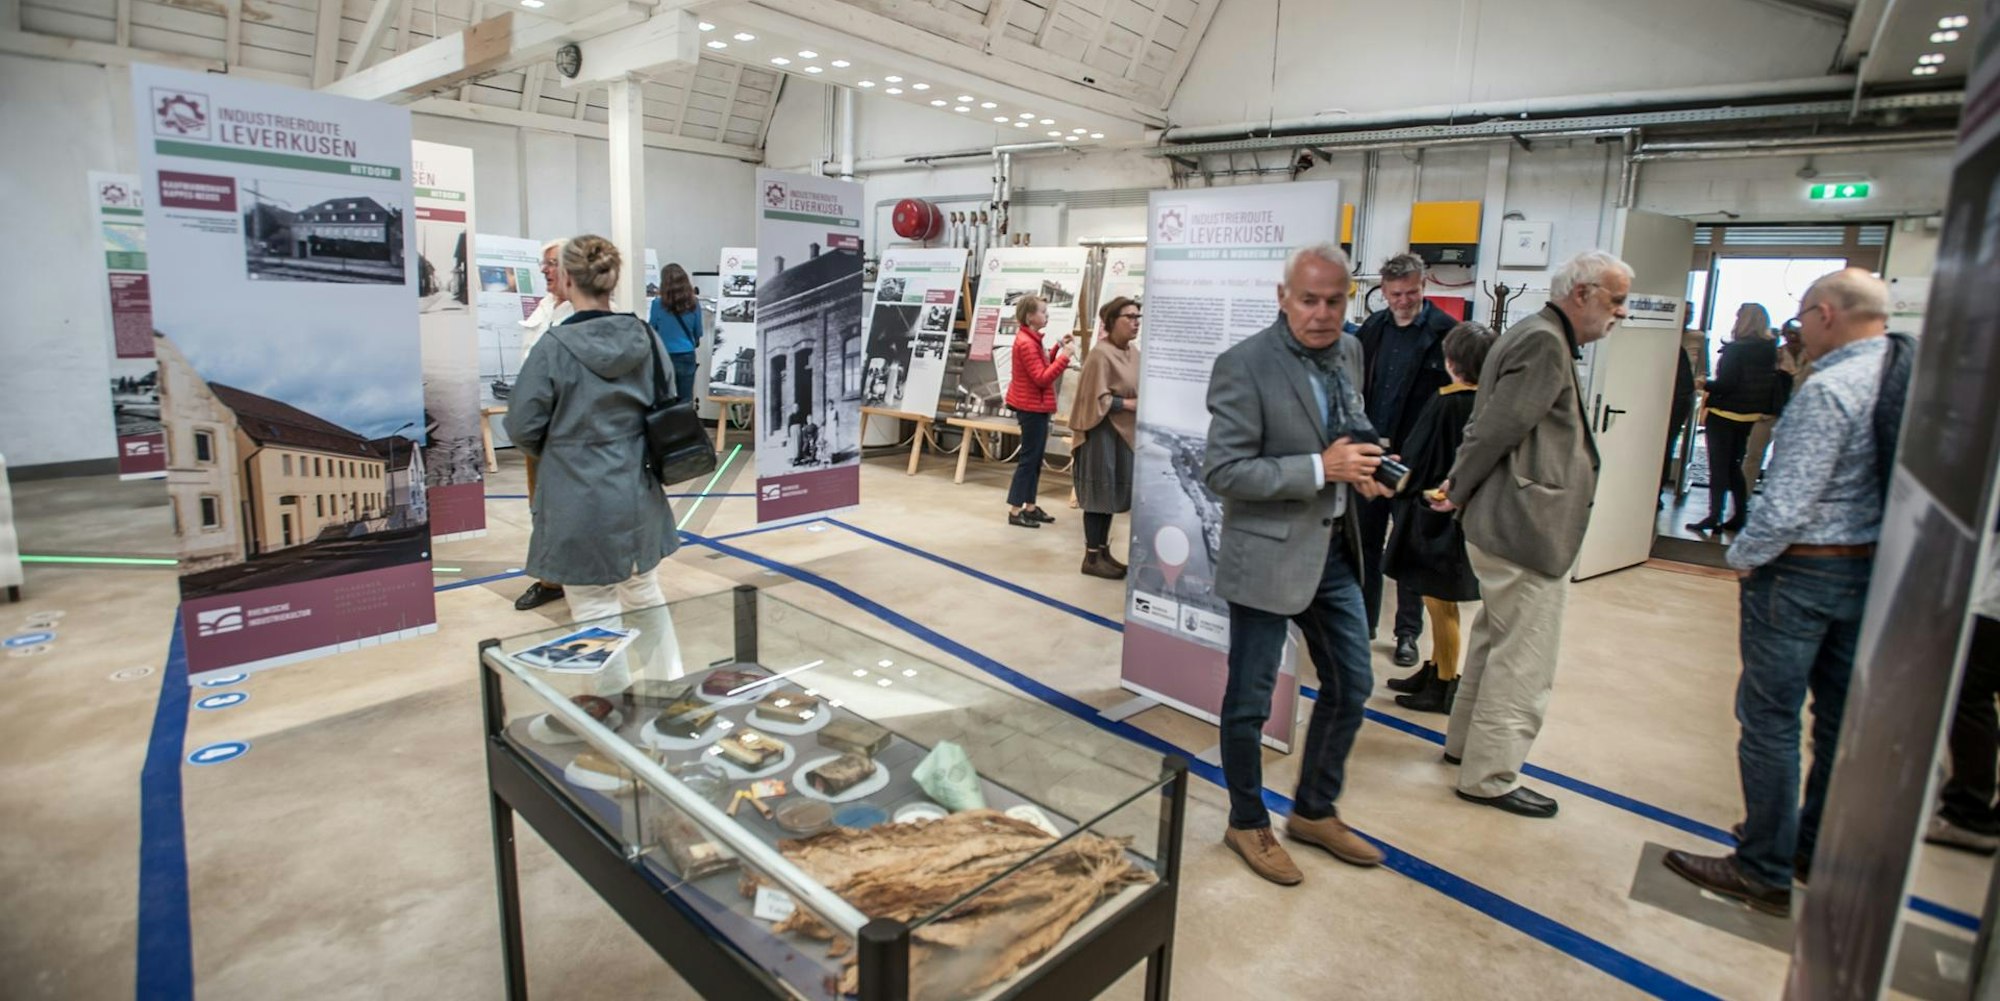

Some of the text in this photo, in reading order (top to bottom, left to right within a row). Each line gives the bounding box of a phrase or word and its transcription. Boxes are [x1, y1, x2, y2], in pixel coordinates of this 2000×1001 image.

[218, 107, 341, 136] INDUSTRIEROUTE
[220, 124, 357, 158] LEVERKUSEN
[350, 164, 393, 177] HITDORF
[789, 199, 844, 216] LEVERKUSEN
[1191, 210, 1273, 224] INDUSTRIEROUTE
[1190, 225, 1285, 244] LEVERKUSEN
